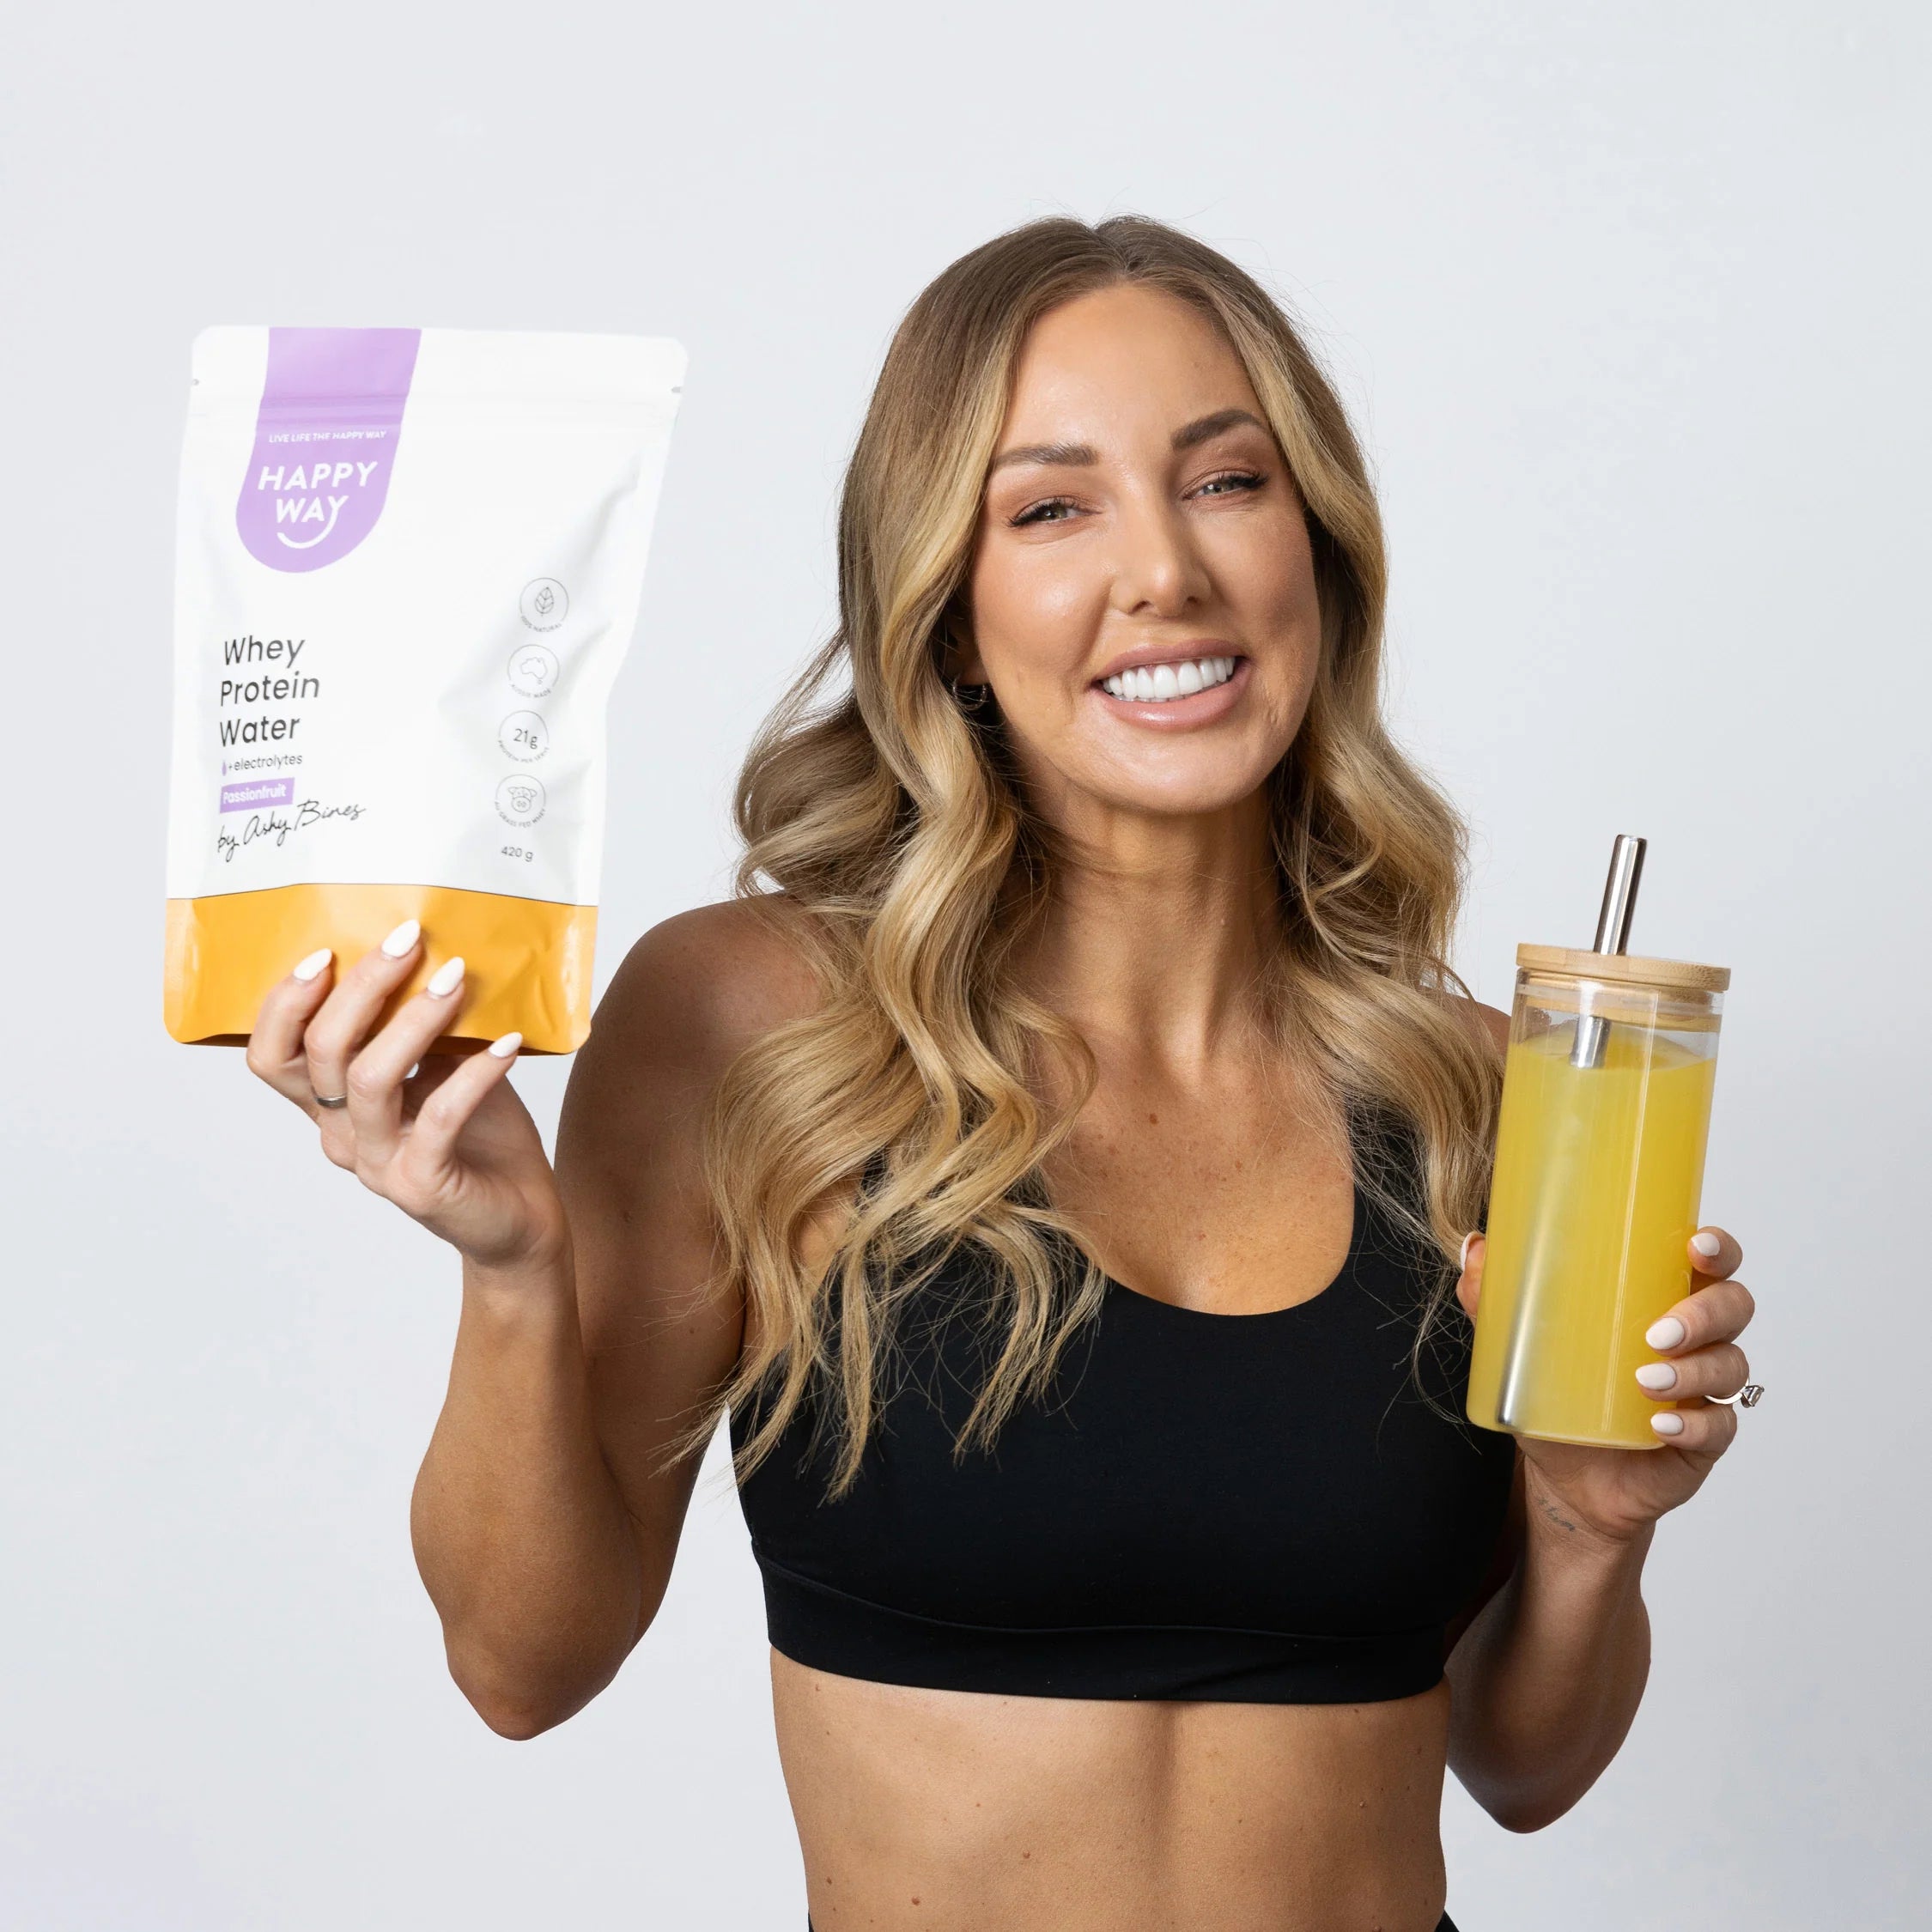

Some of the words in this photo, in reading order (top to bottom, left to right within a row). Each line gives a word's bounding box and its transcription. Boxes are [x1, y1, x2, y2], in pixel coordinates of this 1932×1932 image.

[269, 434, 289, 443] LIVE
[291, 433, 310, 442] LIFE
[313, 432, 331, 441] THE
[332, 431, 364, 440] HAPPY
[365, 430, 386, 440] WAY
[258, 461, 378, 490] HAPPY
[276, 495, 349, 548] WAY
[224, 635, 305, 669] Whey
[220, 671, 320, 707] Protein
[219, 715, 301, 747] Water
[513, 728, 538, 750] 21g
[222, 782, 287, 805] Passionfruit
[217, 825, 240, 863] by
[294, 799, 368, 831] Bines
[501, 846, 523, 858] 420
[525, 851, 534, 863] g
